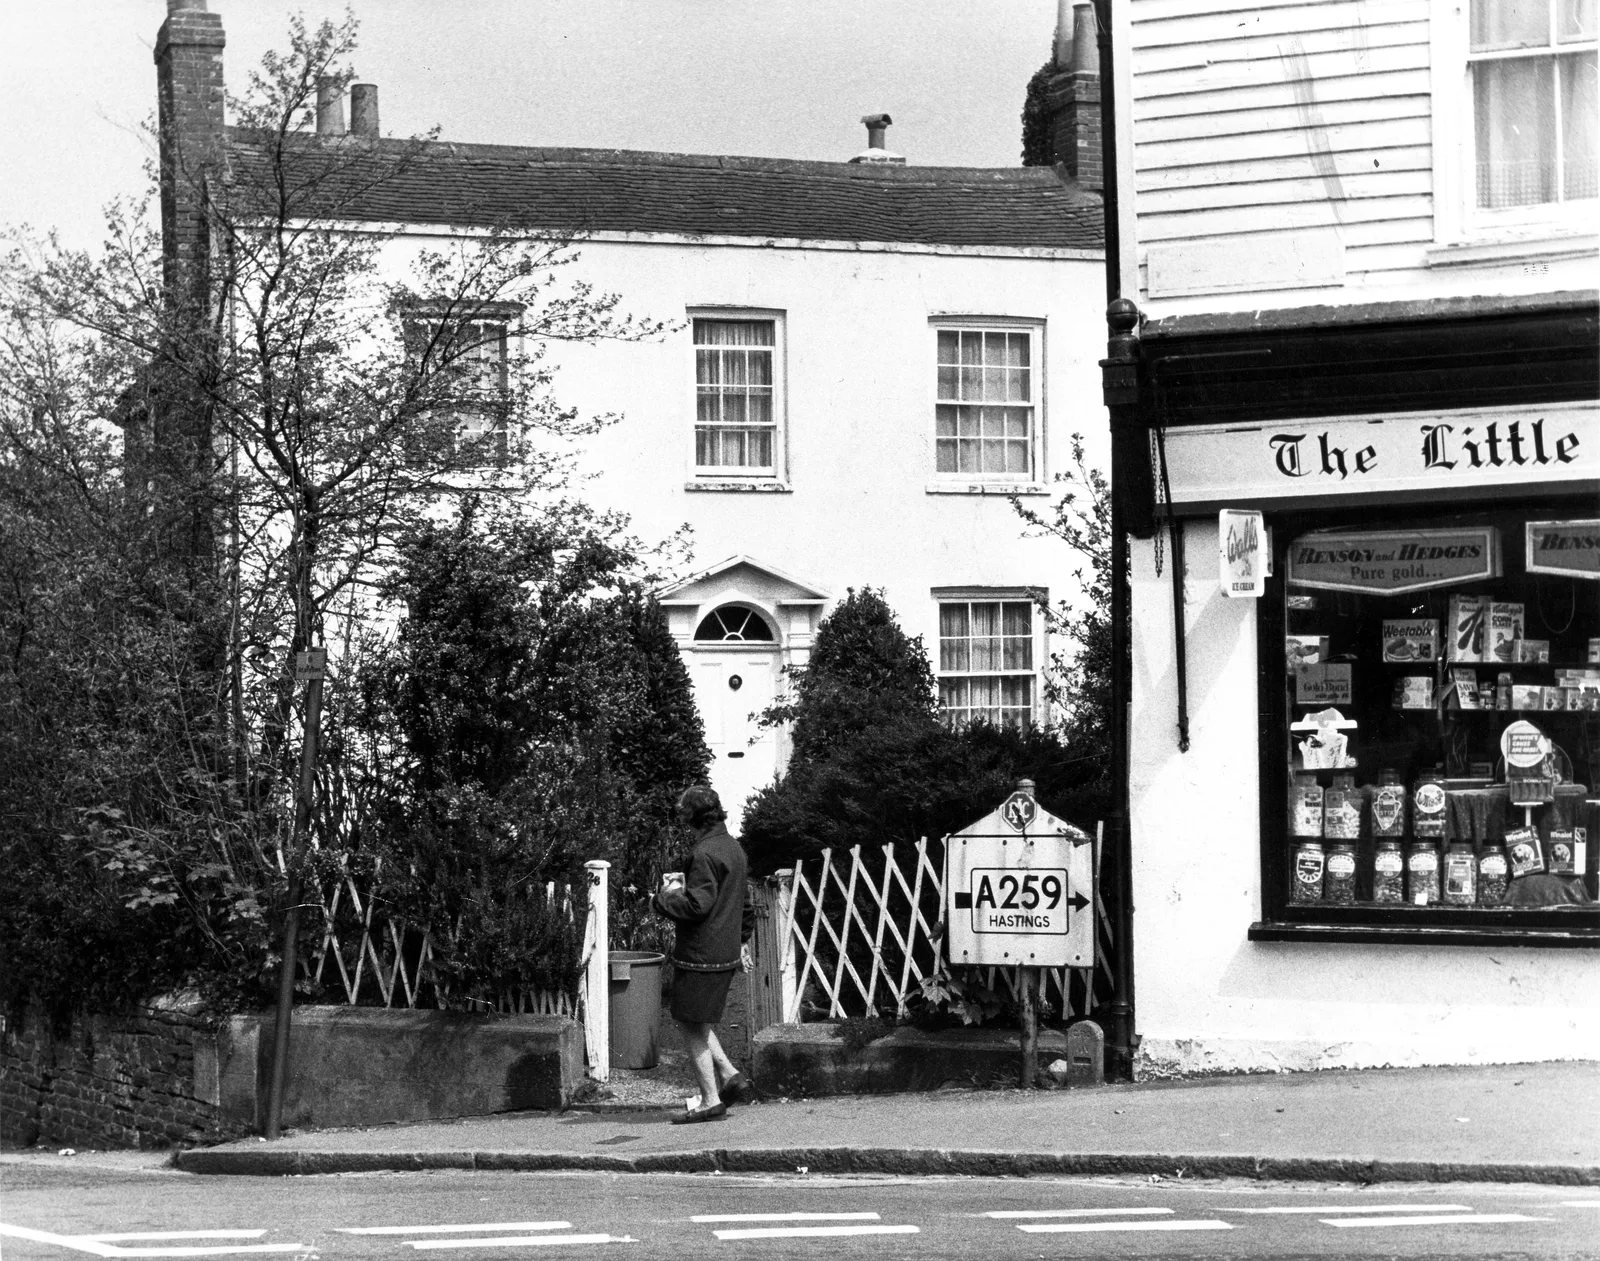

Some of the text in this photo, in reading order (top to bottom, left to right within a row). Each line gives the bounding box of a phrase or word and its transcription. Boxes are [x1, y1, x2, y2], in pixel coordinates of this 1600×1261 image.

[1269, 418, 1580, 481] The Little
[1297, 543, 1482, 564] BENSON and HEDGES
[1350, 566, 1385, 580] Pure
[1231, 582, 1255, 591] ICE CREAM
[1492, 615, 1512, 623] CORN
[1383, 625, 1433, 638] Weetabix
[975, 874, 1062, 910] A259
[989, 914, 1050, 928] HASTINGS
